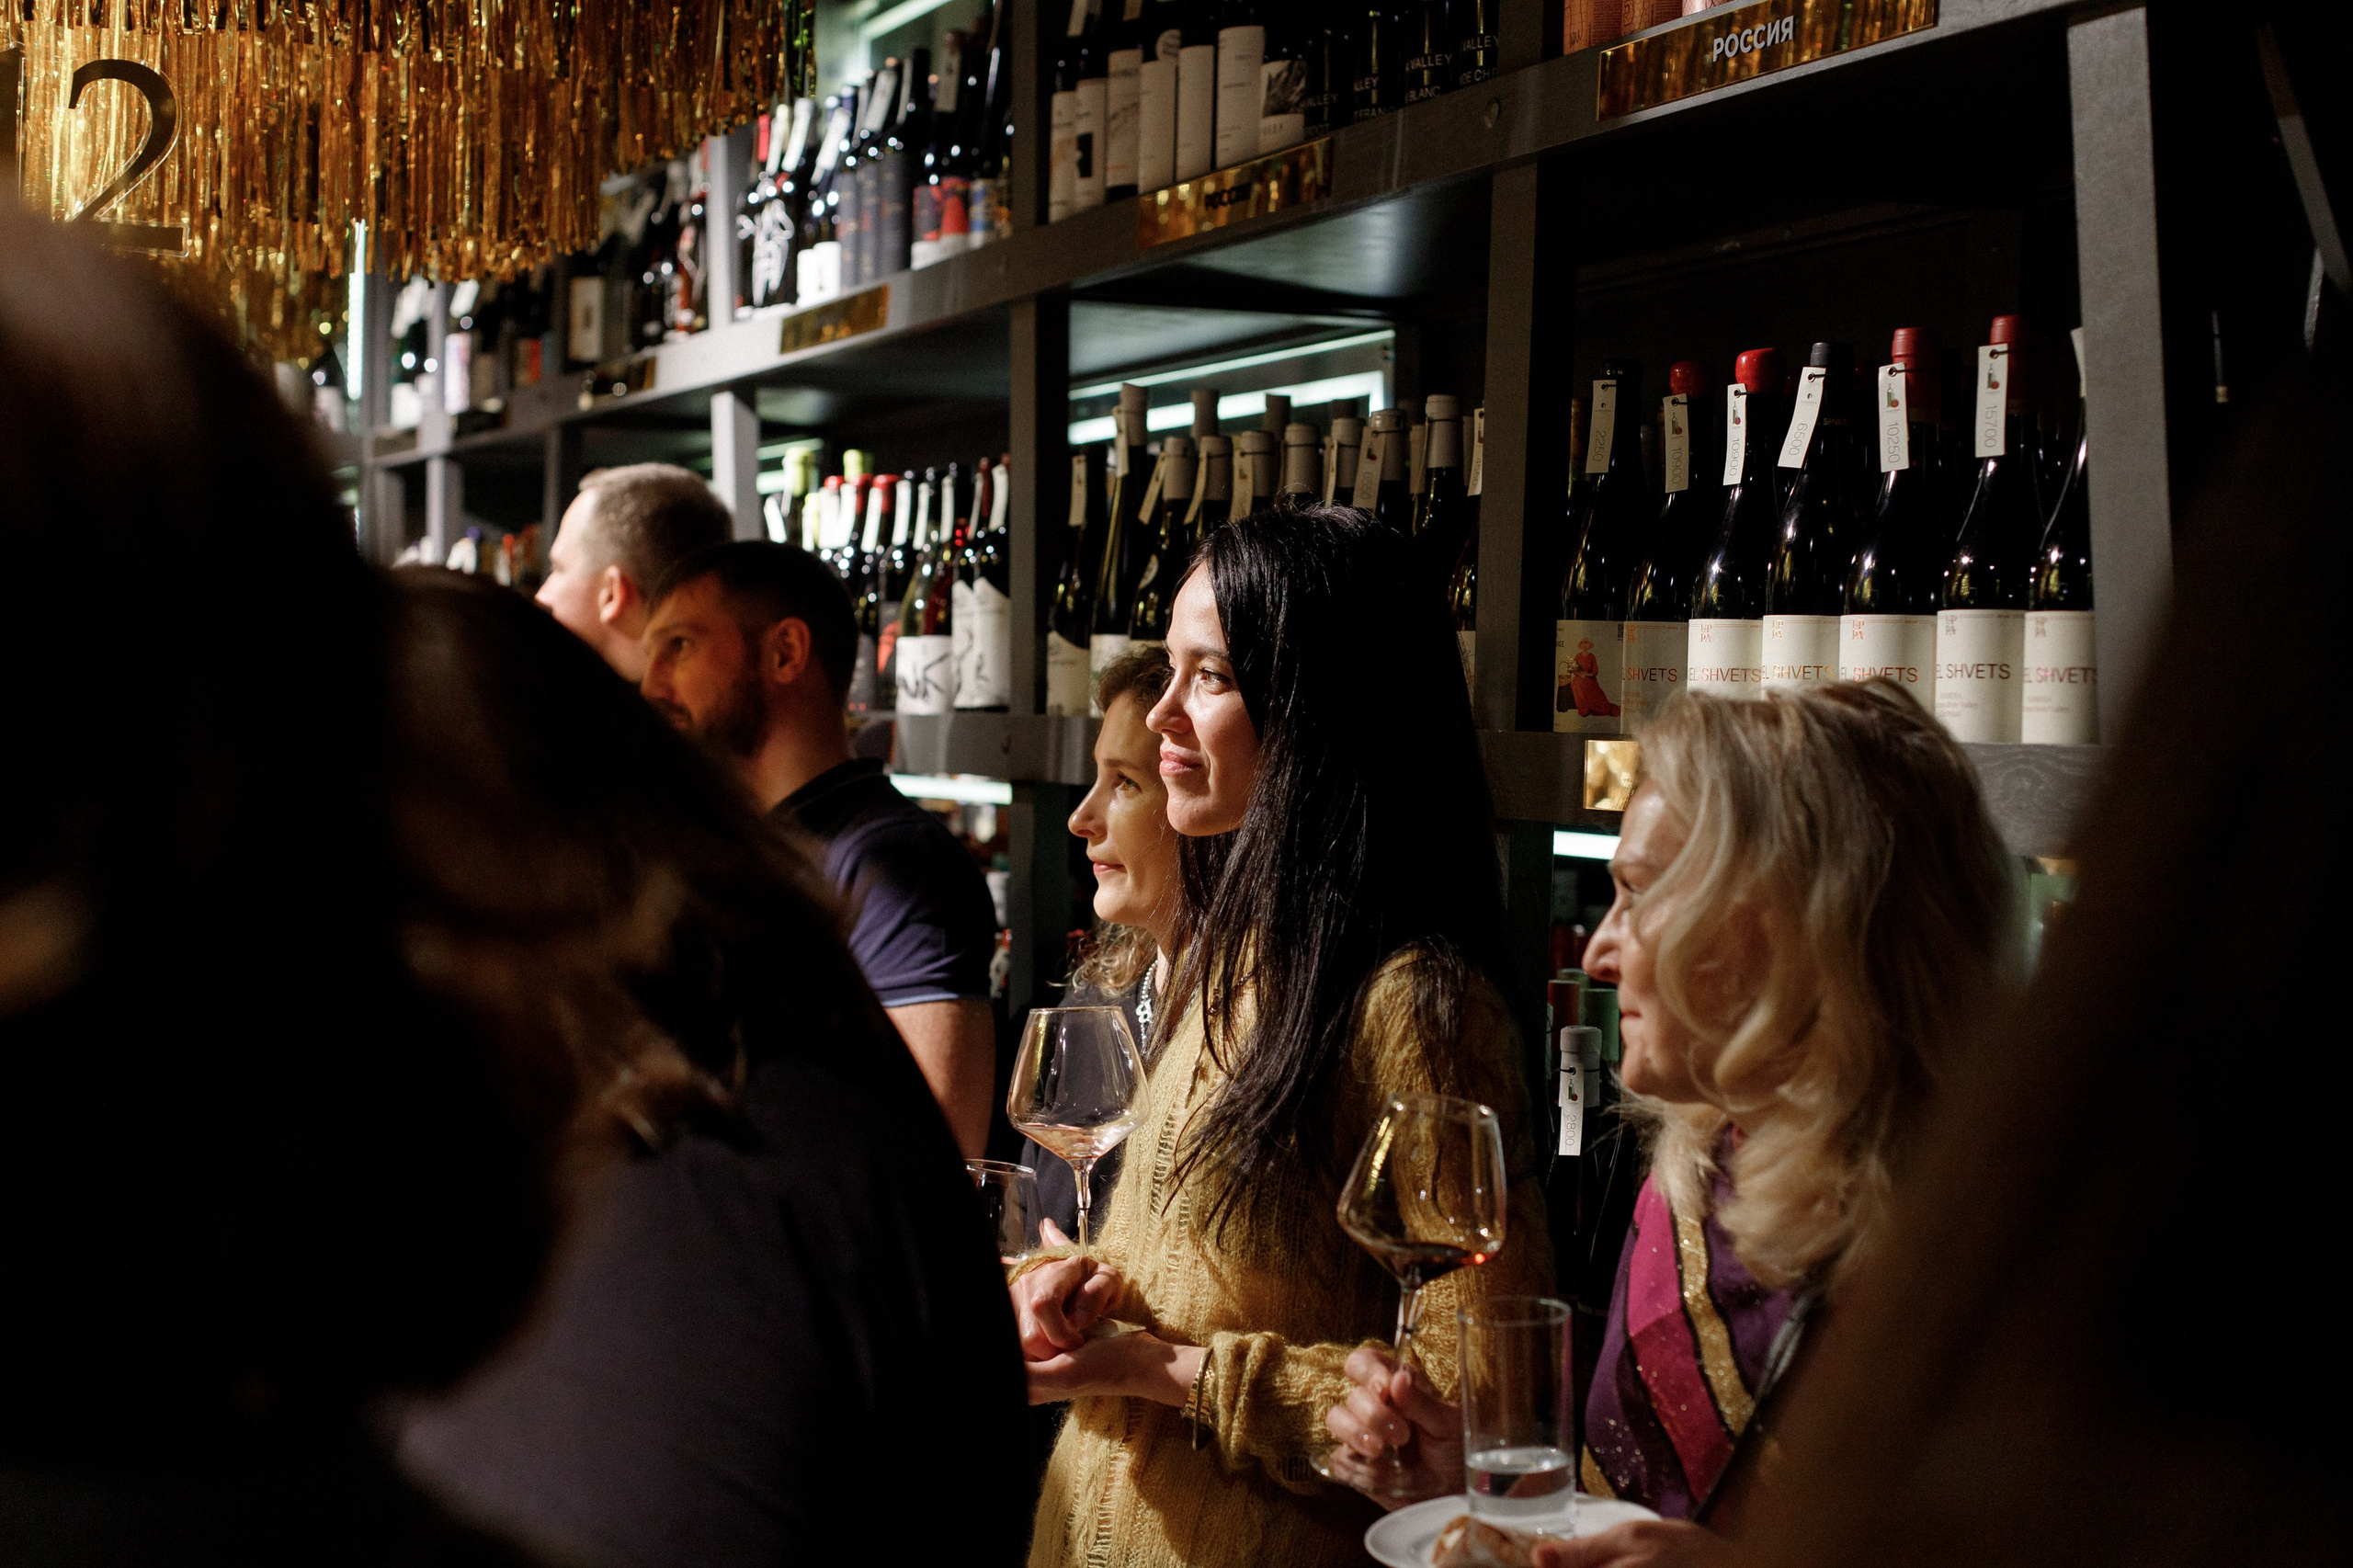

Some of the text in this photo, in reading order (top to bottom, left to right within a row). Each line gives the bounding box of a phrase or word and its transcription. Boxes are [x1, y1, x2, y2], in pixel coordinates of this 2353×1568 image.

[1712, 15, 1794, 62] РОССИЯ
[1788, 423, 1808, 456] 6500
[1887, 421, 1901, 464] 10250
[1984, 404, 1998, 449] 15700
[1593, 429, 1607, 462] 2250
[1729, 438, 1740, 477] 10900
[1672, 448, 1683, 484] 10900
[1627, 667, 1678, 682] SHVETS
[1701, 667, 1762, 683] SHVETS
[1773, 665, 1836, 680] SHVETS
[1852, 667, 1918, 682] SHVETS
[1946, 663, 2011, 679] SHVETS
[1565, 1114, 1576, 1146] 2800
